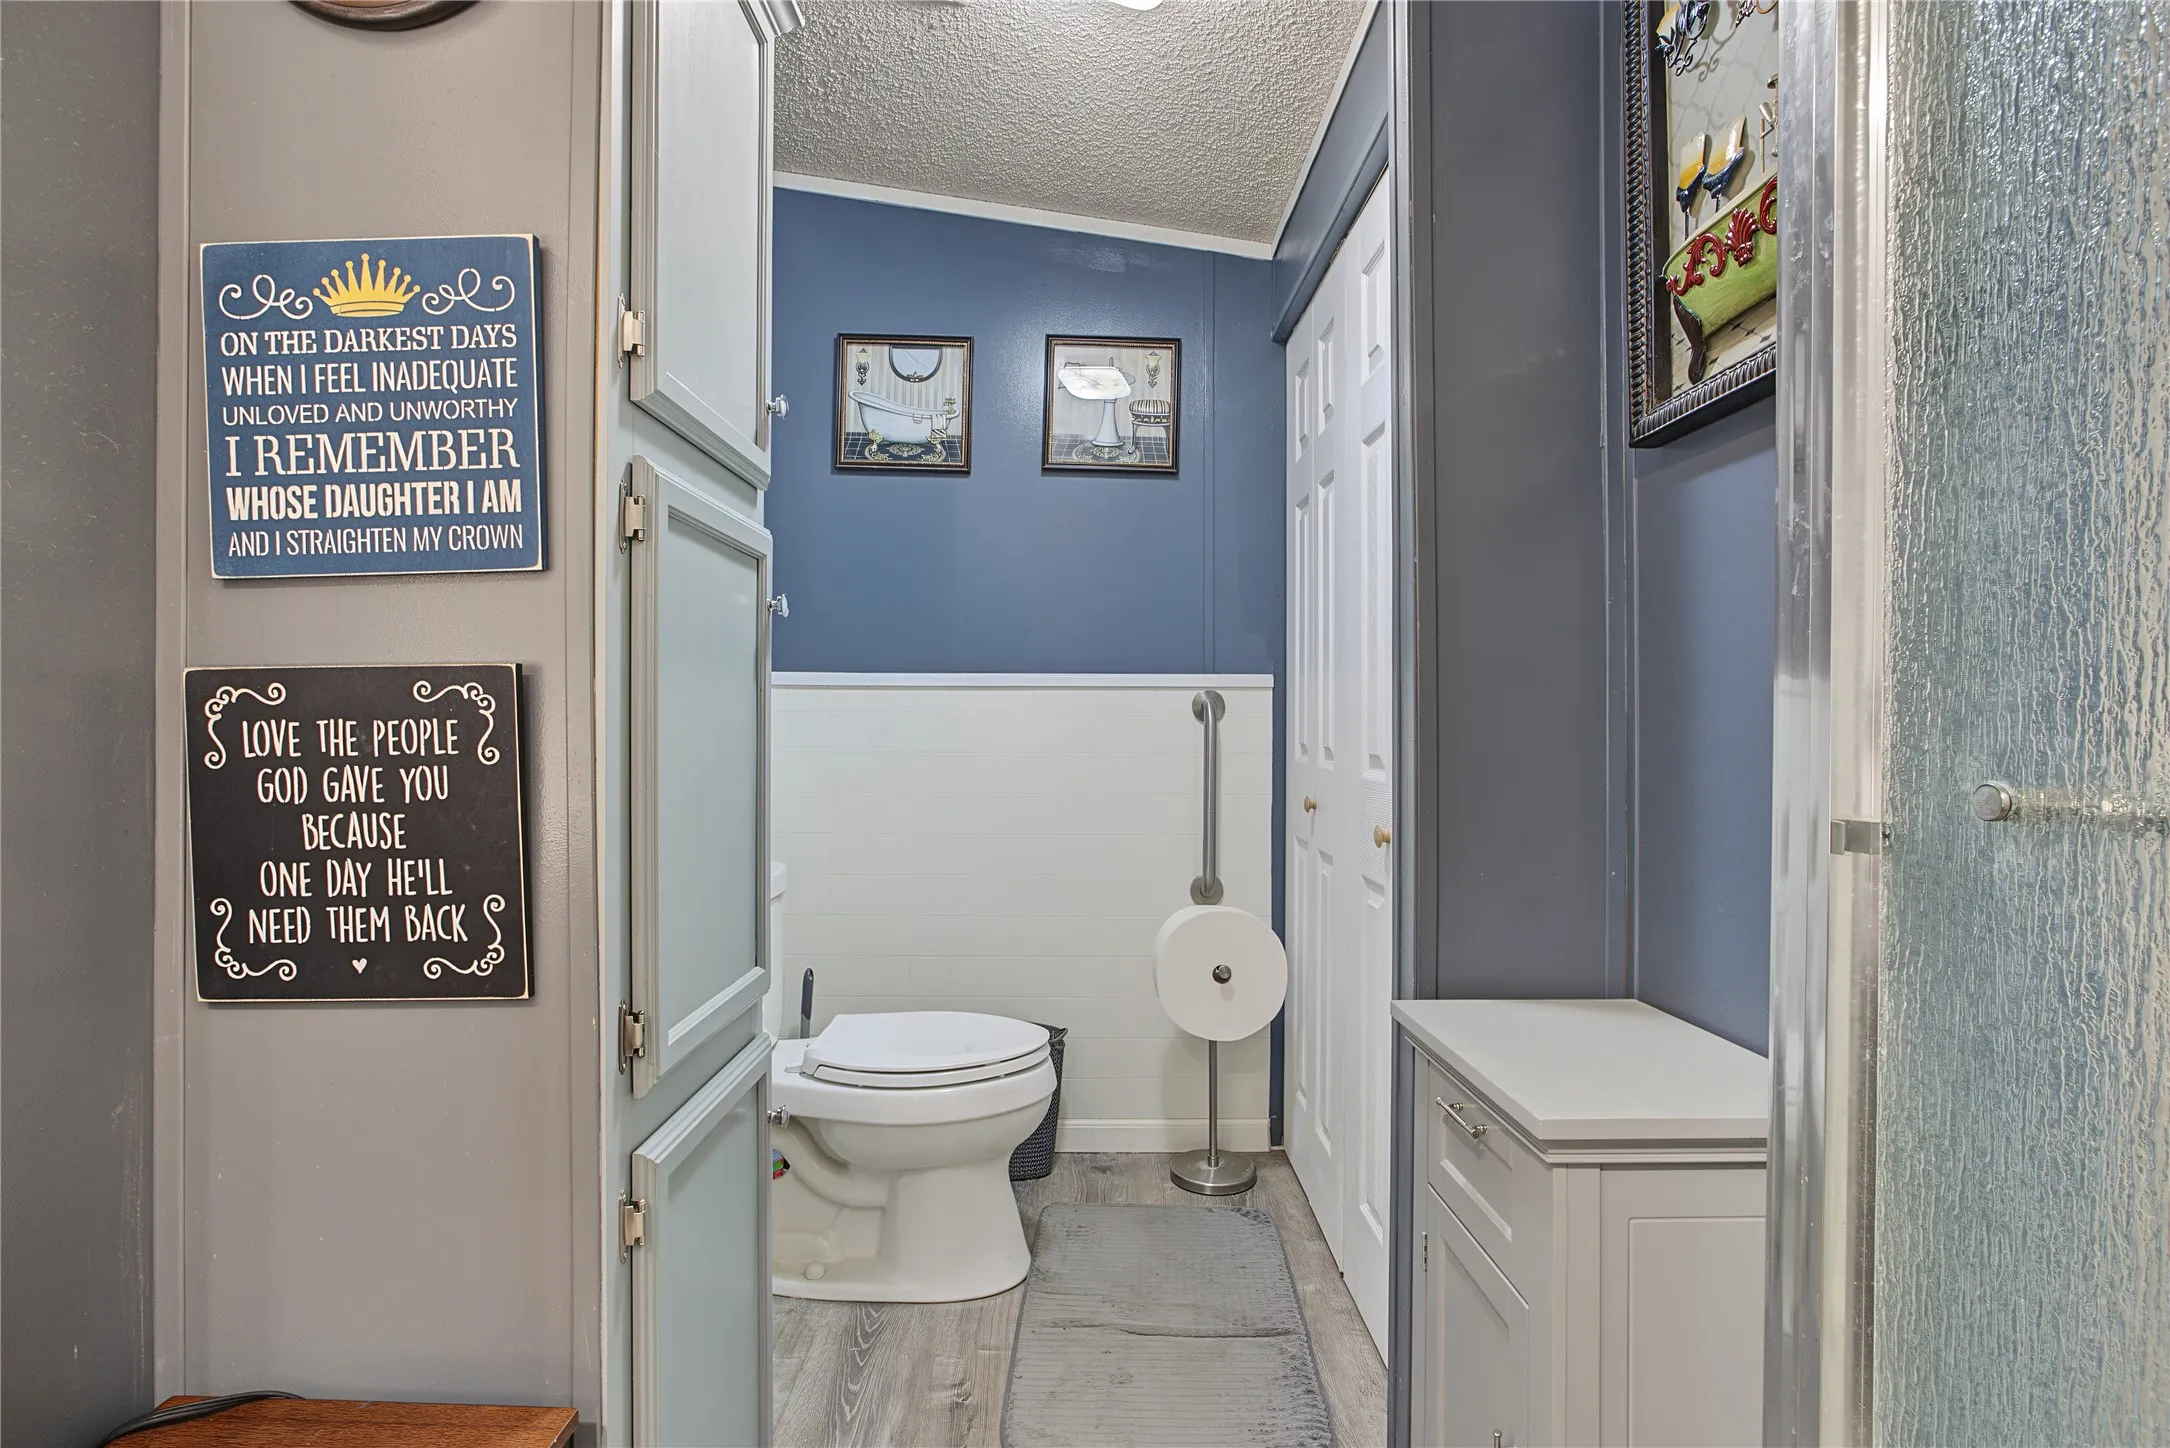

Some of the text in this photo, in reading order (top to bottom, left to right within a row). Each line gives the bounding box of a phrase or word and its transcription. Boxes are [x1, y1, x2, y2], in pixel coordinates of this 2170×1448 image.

[220, 324, 517, 357] ON THE DARKEST DAYS
[222, 358, 518, 396] WHEN I FEEL INADEQUATE
[223, 398, 518, 425] UNLOVED AND UNWORTHY
[225, 428, 520, 476] I REMEMBER
[226, 479, 521, 520] WHOSE DAUGHTER I AM
[228, 524, 523, 557] AND I STRAIGHTEN MY CROWN
[242, 719, 459, 758] LOVE THE PEOPLE
[257, 765, 448, 804] GOD GAVE YOU
[302, 812, 406, 850] BECAUSE
[260, 858, 452, 897] ONE DAY HE'LL
[248, 904, 468, 944] NEED THEM BACK
